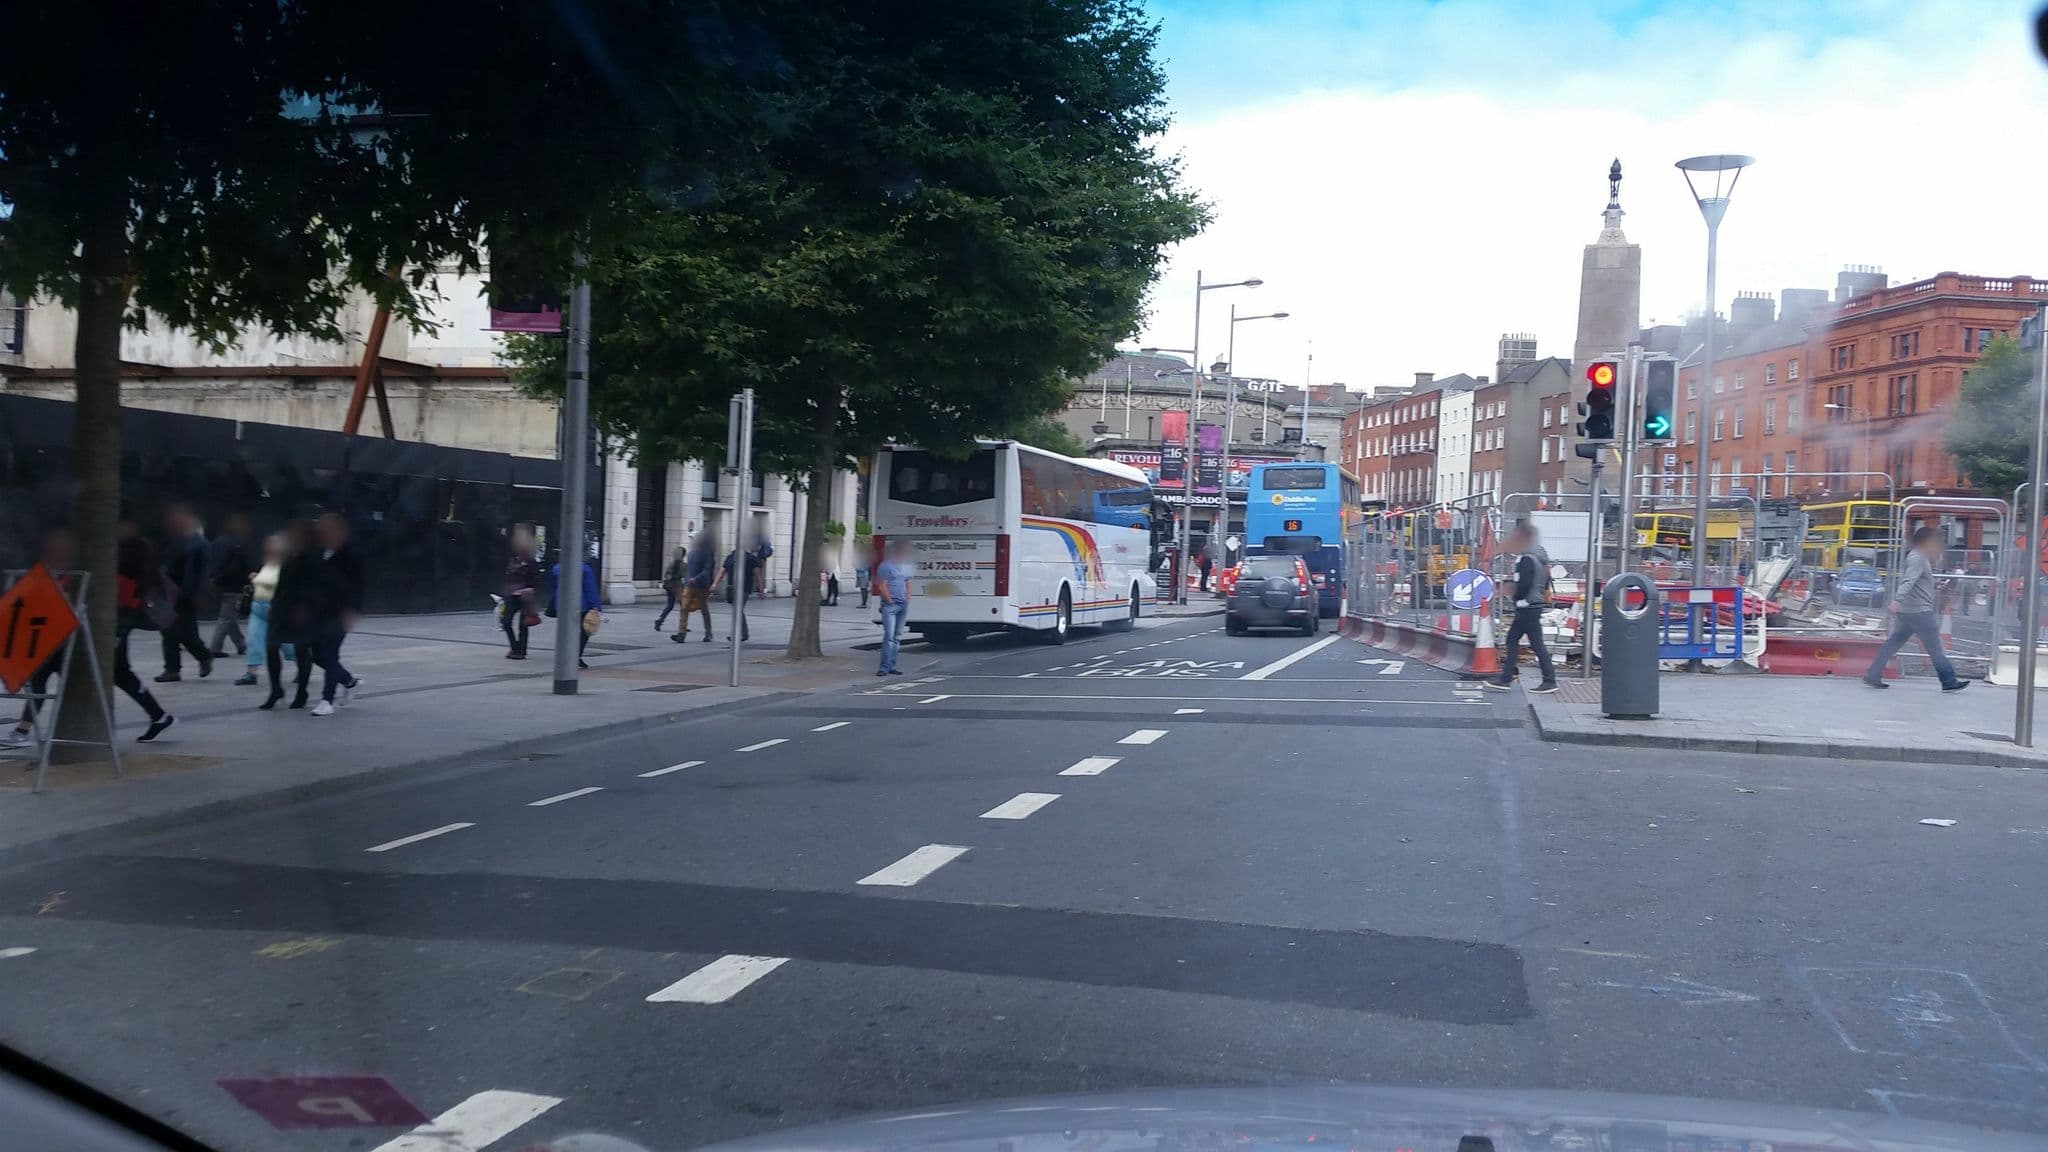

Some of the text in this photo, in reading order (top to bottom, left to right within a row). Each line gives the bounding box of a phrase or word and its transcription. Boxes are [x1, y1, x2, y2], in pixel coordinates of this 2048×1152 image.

[1247, 381, 1285, 393] GATE
[906, 514, 969, 527] Travellers
[1288, 520, 1298, 531] 16
